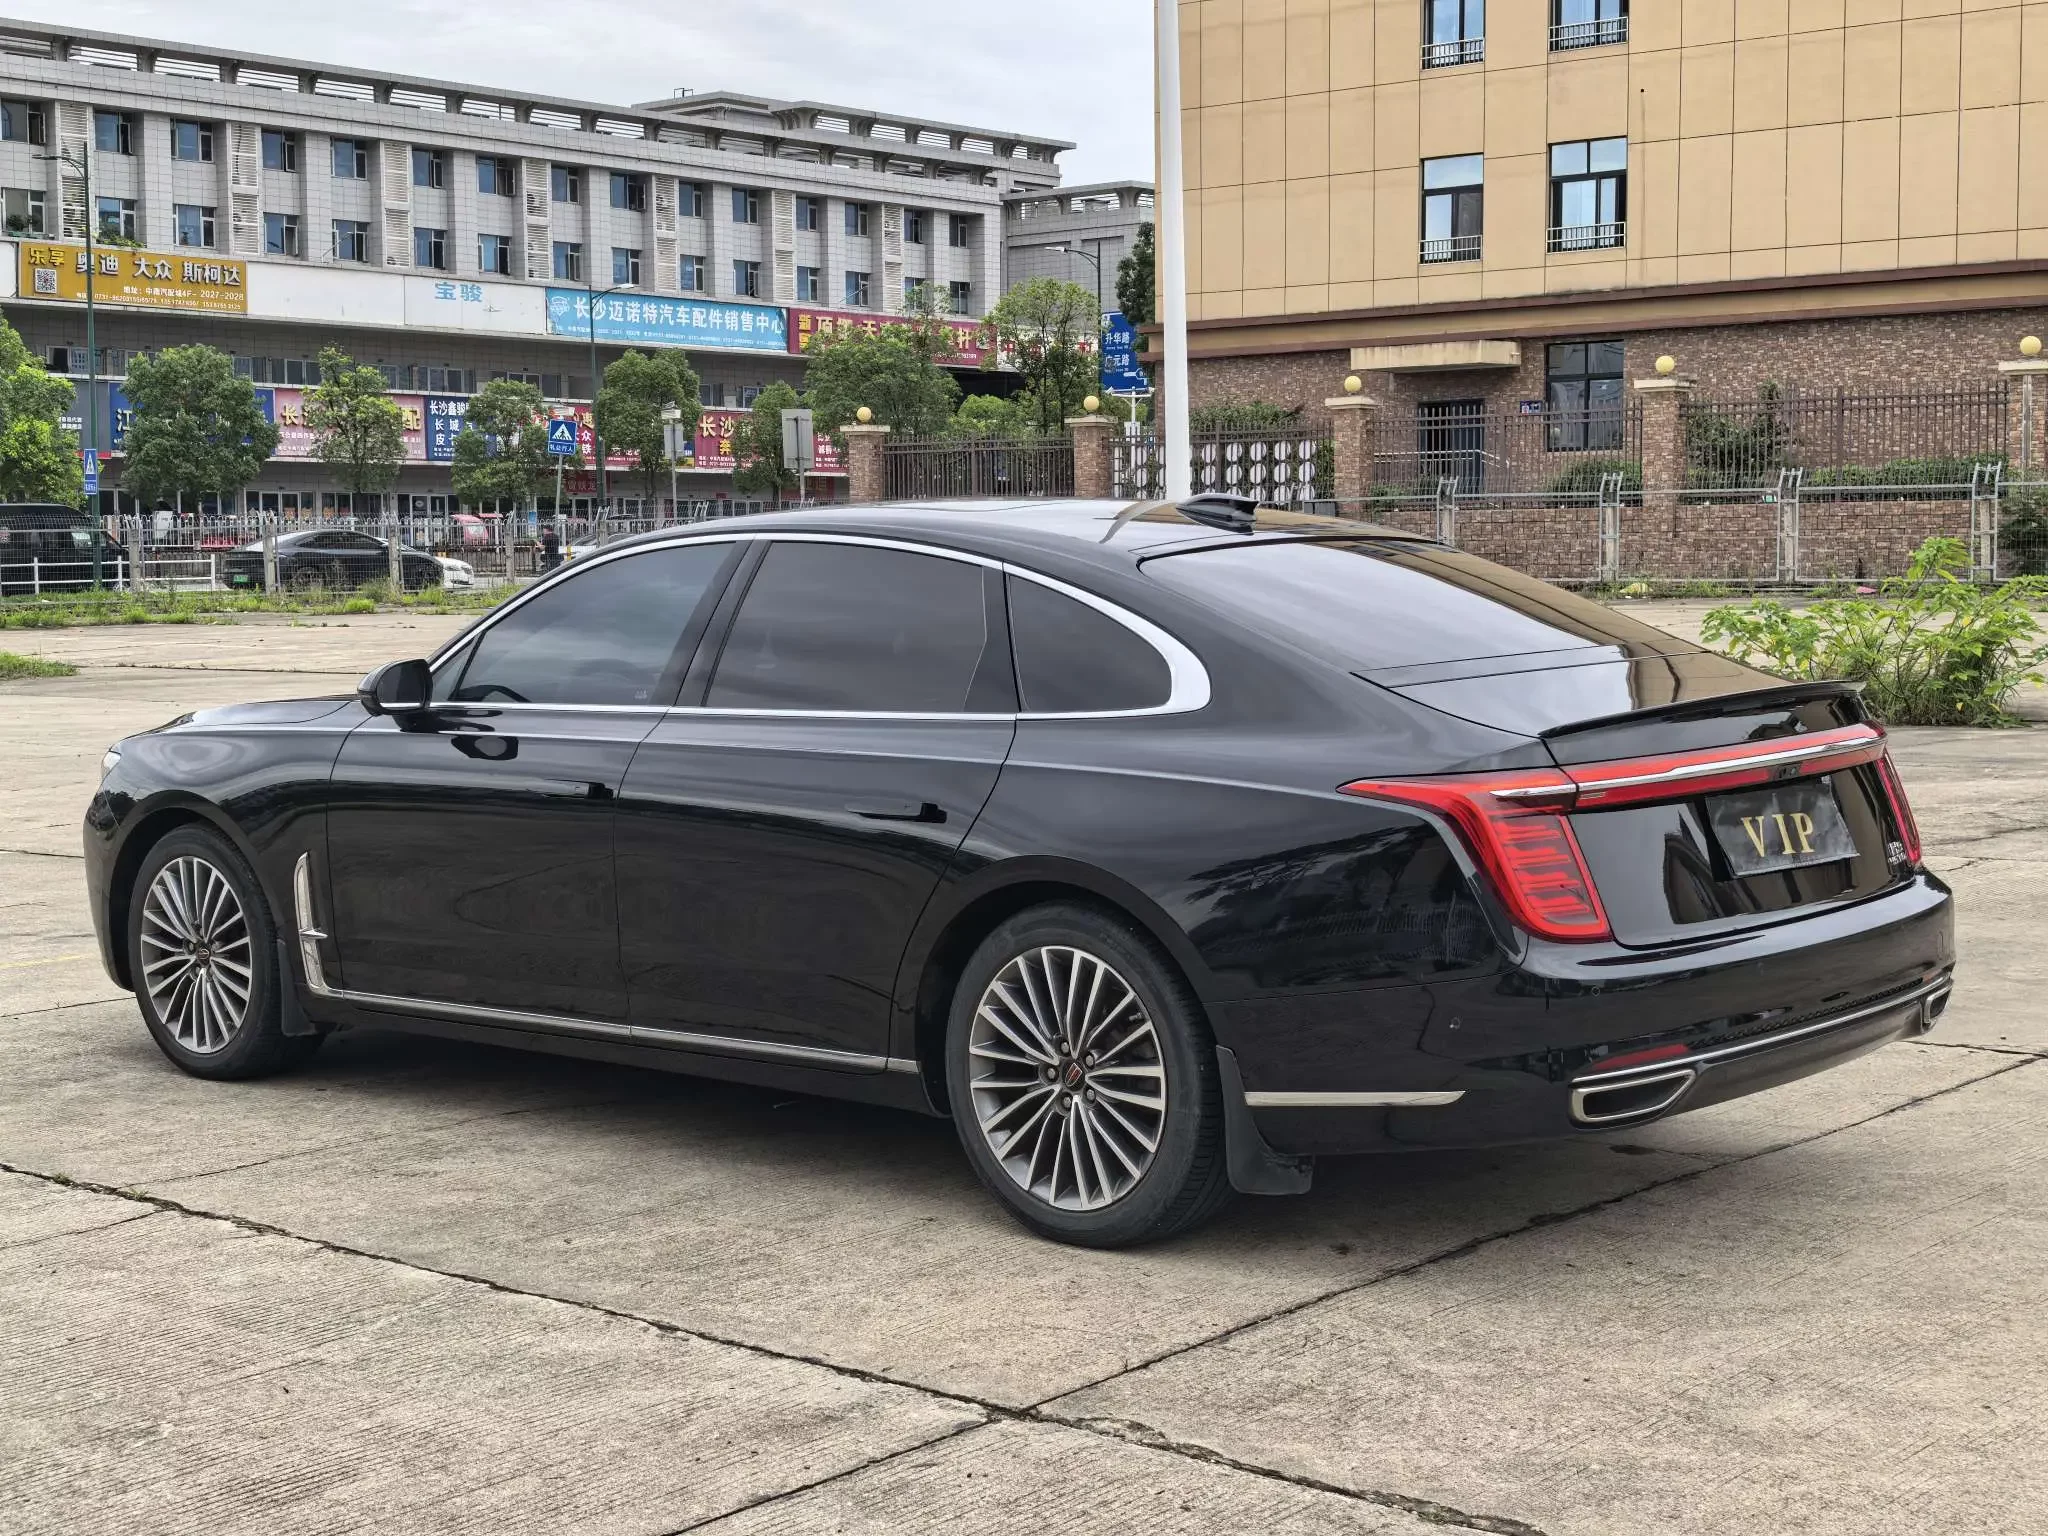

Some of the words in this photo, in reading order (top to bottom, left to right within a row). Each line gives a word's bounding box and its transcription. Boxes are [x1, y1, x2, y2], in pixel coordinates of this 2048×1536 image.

[28, 247, 65, 266] 乐享
[76, 251, 119, 275] 奥迪
[133, 257, 173, 280] 大众
[182, 261, 242, 286] 斯柯达
[434, 281, 483, 302] 宝骏
[574, 296, 784, 334] 长沙迈诺特汽车配件销售中心
[1105, 331, 1130, 345] 升华路
[1104, 354, 1130, 367] 广元路
[430, 400, 469, 416] 长沙鑫骏
[1740, 812, 1816, 858] VIP
